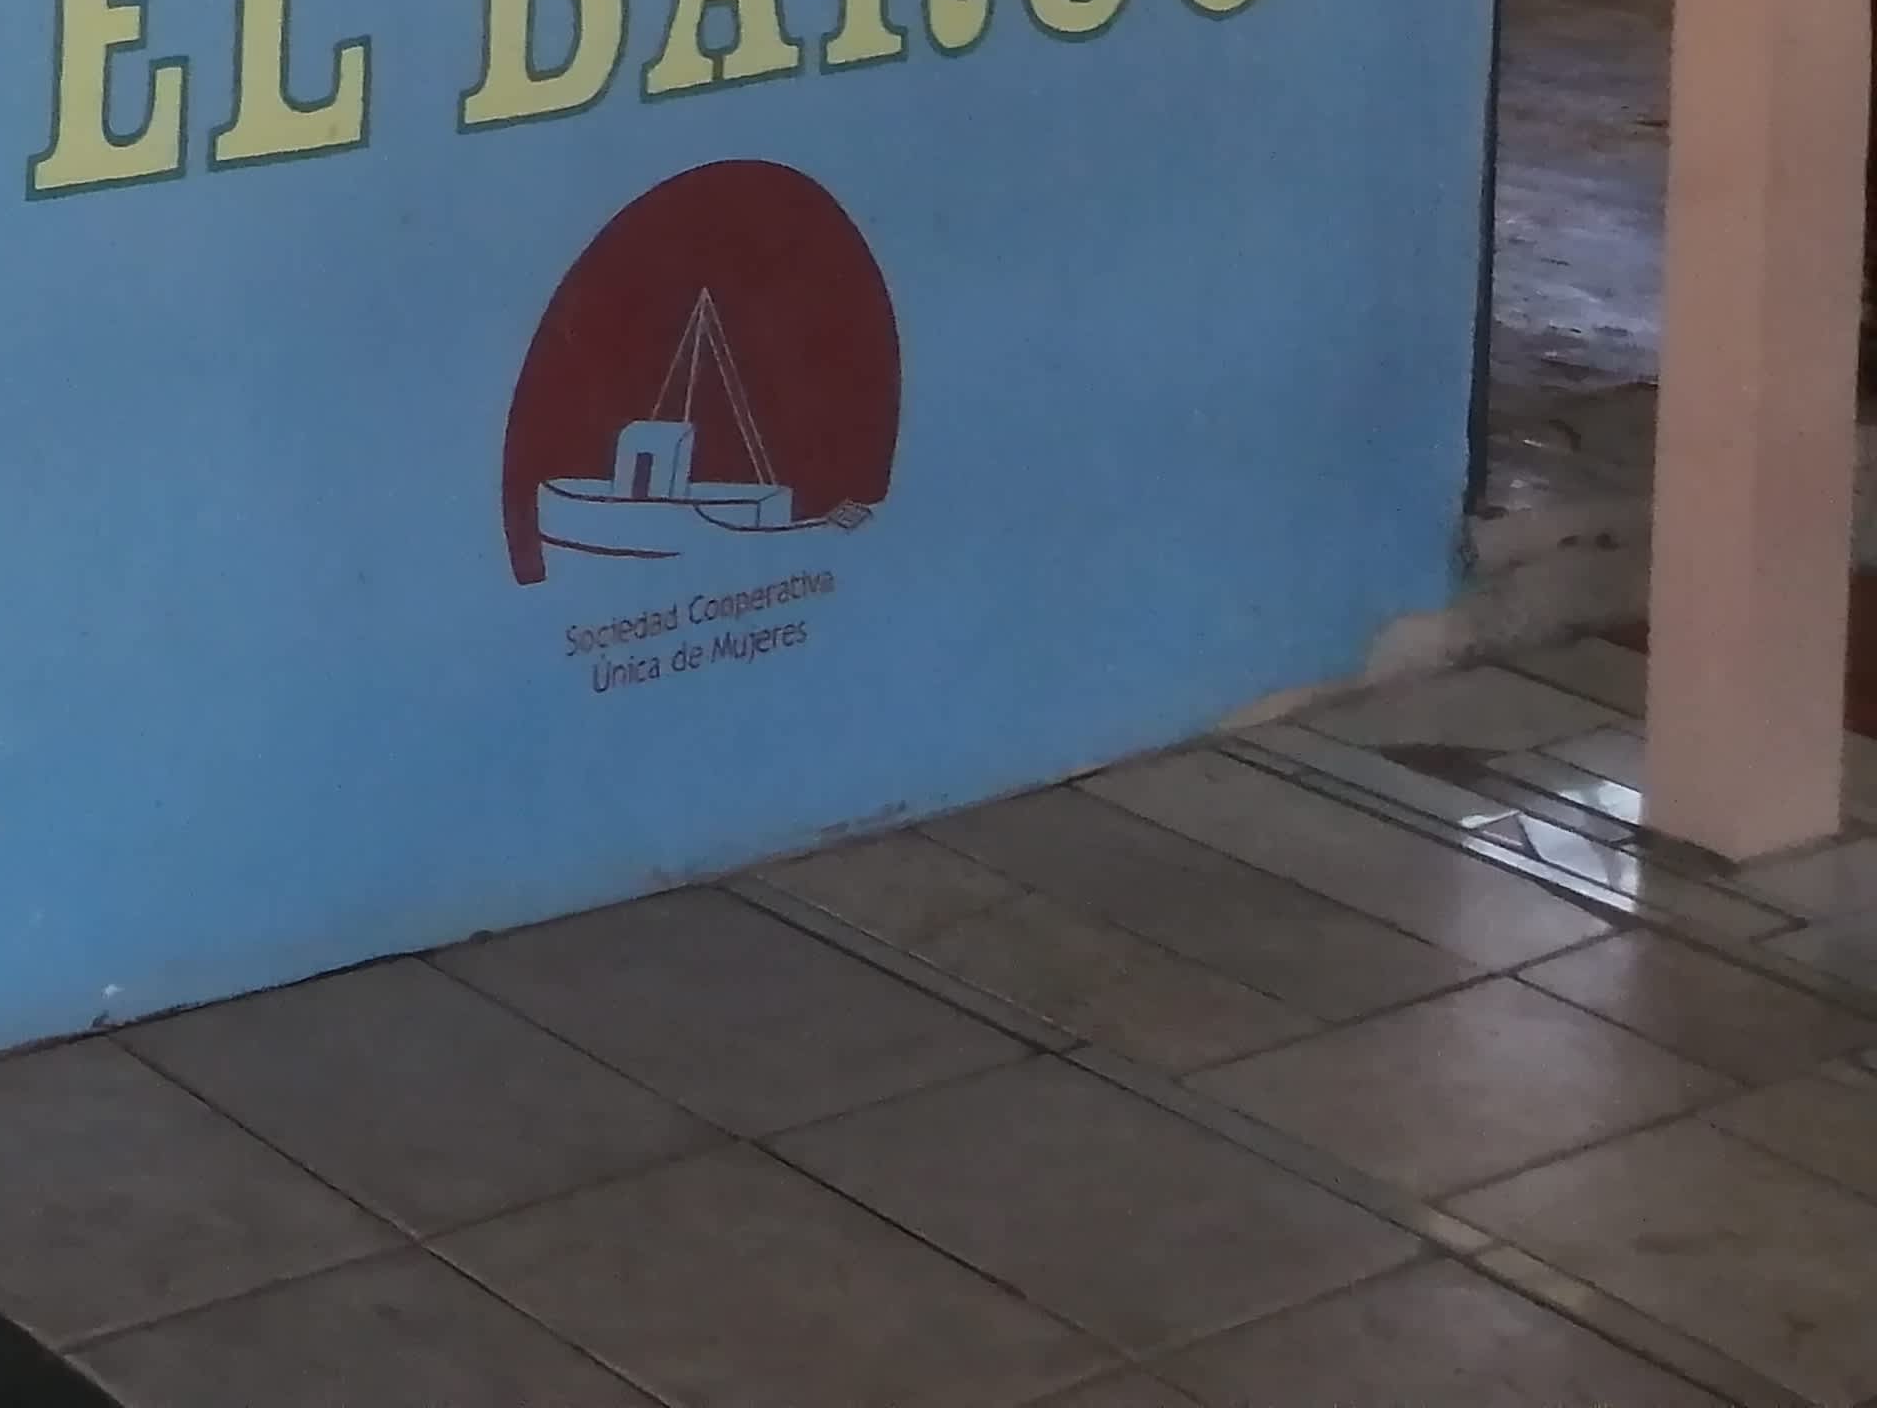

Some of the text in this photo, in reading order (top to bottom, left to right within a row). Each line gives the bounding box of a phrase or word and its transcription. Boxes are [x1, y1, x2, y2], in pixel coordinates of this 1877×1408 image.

[565, 570, 836, 656] Sociedad Cooperativa
[670, 643, 705, 672] de
[710, 620, 808, 664] Mujeres
